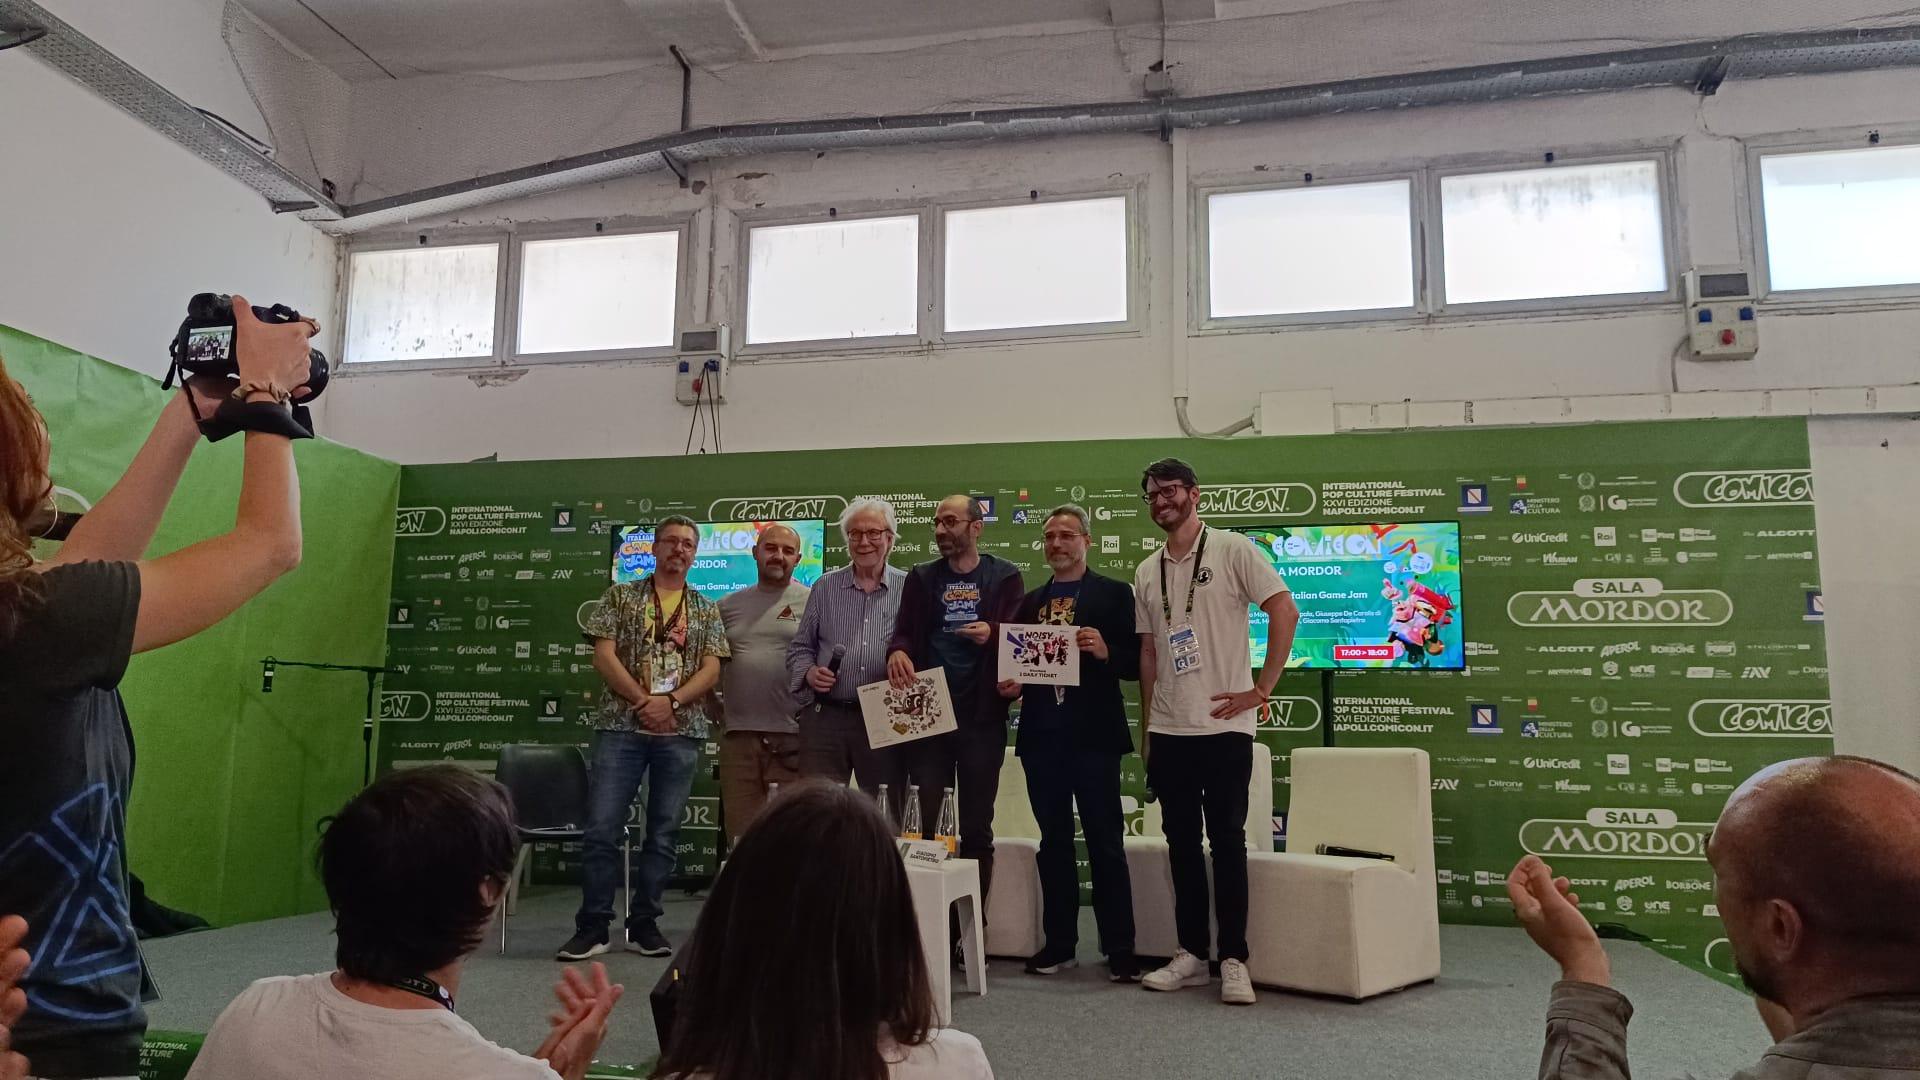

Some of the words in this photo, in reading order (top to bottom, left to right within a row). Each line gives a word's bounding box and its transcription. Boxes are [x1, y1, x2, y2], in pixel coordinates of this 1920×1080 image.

[1322, 481, 1405, 490] INTERNATIONAL
[1703, 474, 1814, 502] COMICO
[1322, 490, 1340, 499] POP
[1342, 489, 1392, 498] CULTURE
[1394, 488, 1445, 497] FESTIVAL
[1322, 498, 1345, 507] XXVI
[1347, 498, 1393, 507] EDIZIONE
[451, 505, 514, 513] INTERNATIONAL
[1322, 506, 1425, 515] NAPOLI.COMICON.IT
[450, 527, 527, 535] NAPOLI.COMICON.IT
[1524, 533, 1568, 543] UniCredit
[691, 560, 728, 569] ORDOR
[1289, 566, 1342, 576] MORDOR
[1592, 582, 1644, 594] SALA
[944, 591, 978, 600] GAME
[1291, 592, 1318, 600] talian
[1318, 592, 1346, 600] Game
[1347, 591, 1368, 599] Jam
[948, 601, 974, 611] JAM
[1529, 598, 1711, 622] MORDOR
[1600, 640, 1641, 658] APEROL
[1333, 697, 1413, 706] NTERNATIONAL
[1333, 706, 1349, 714] OP
[1350, 706, 1400, 714] CULTURE
[1401, 707, 1454, 715] FESTIVAL
[434, 714, 514, 722] NAPOLI.COMICON.IT
[1333, 715, 1352, 723] XVI
[1353, 715, 1400, 723] EDIZIONE
[1719, 703, 1832, 732] COMICO
[1535, 759, 1581, 769] UniCredit
[1605, 811, 1658, 824] SALA
[1614, 876, 1655, 892] APEROL
[1665, 879, 1712, 891] BORBONE
